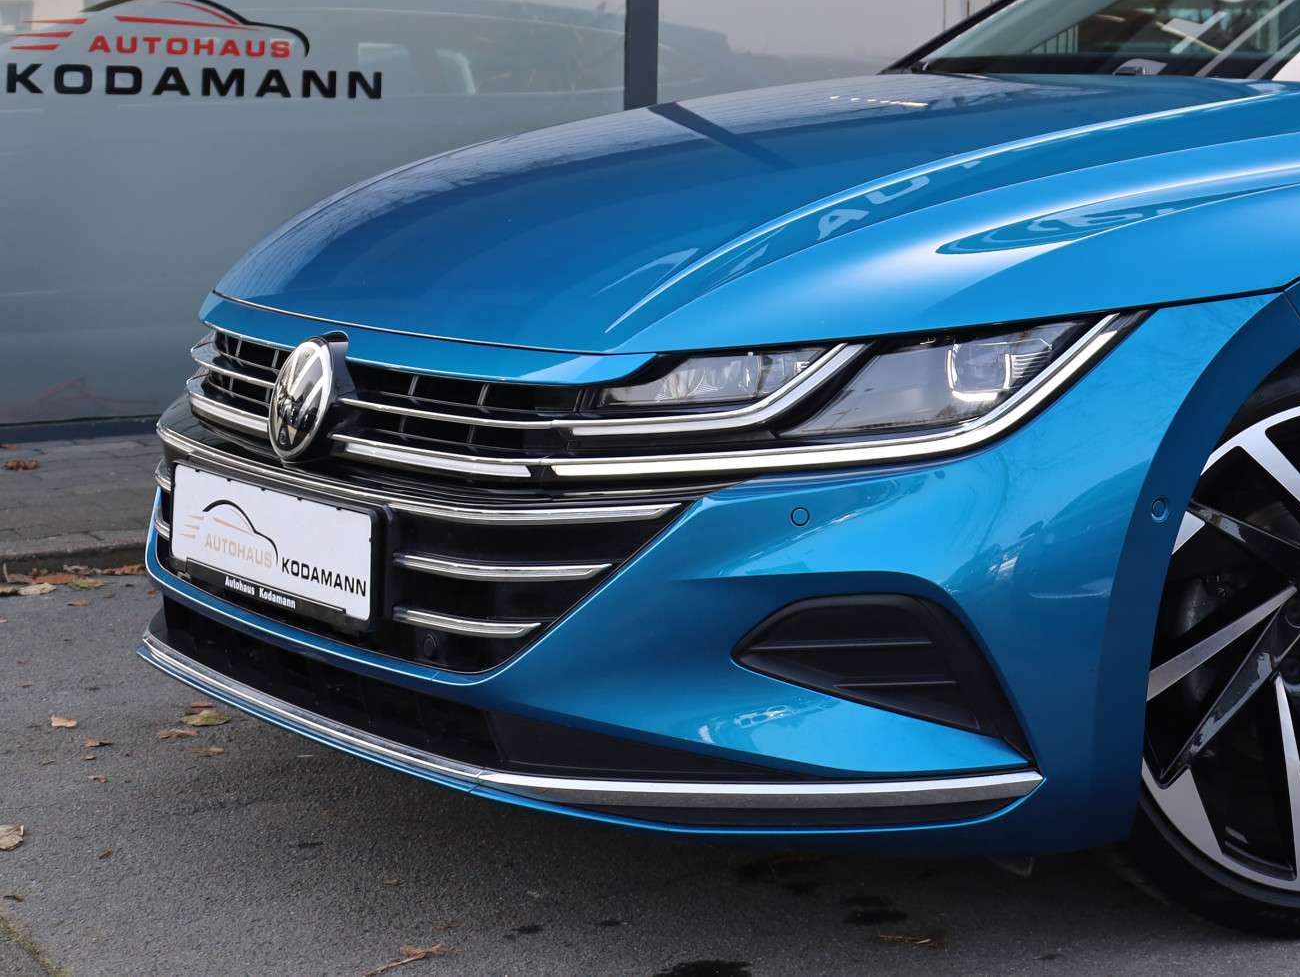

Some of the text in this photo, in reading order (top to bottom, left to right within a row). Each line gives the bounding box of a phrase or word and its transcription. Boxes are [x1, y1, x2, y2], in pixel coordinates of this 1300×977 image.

[88, 34, 291, 59] AUTOHAUS
[6, 62, 383, 100] KODAMANN
[204, 532, 273, 569] AUTOHAUS
[224, 575, 297, 610] Autohaus Kodamann
[281, 556, 367, 597] KODAMANN
